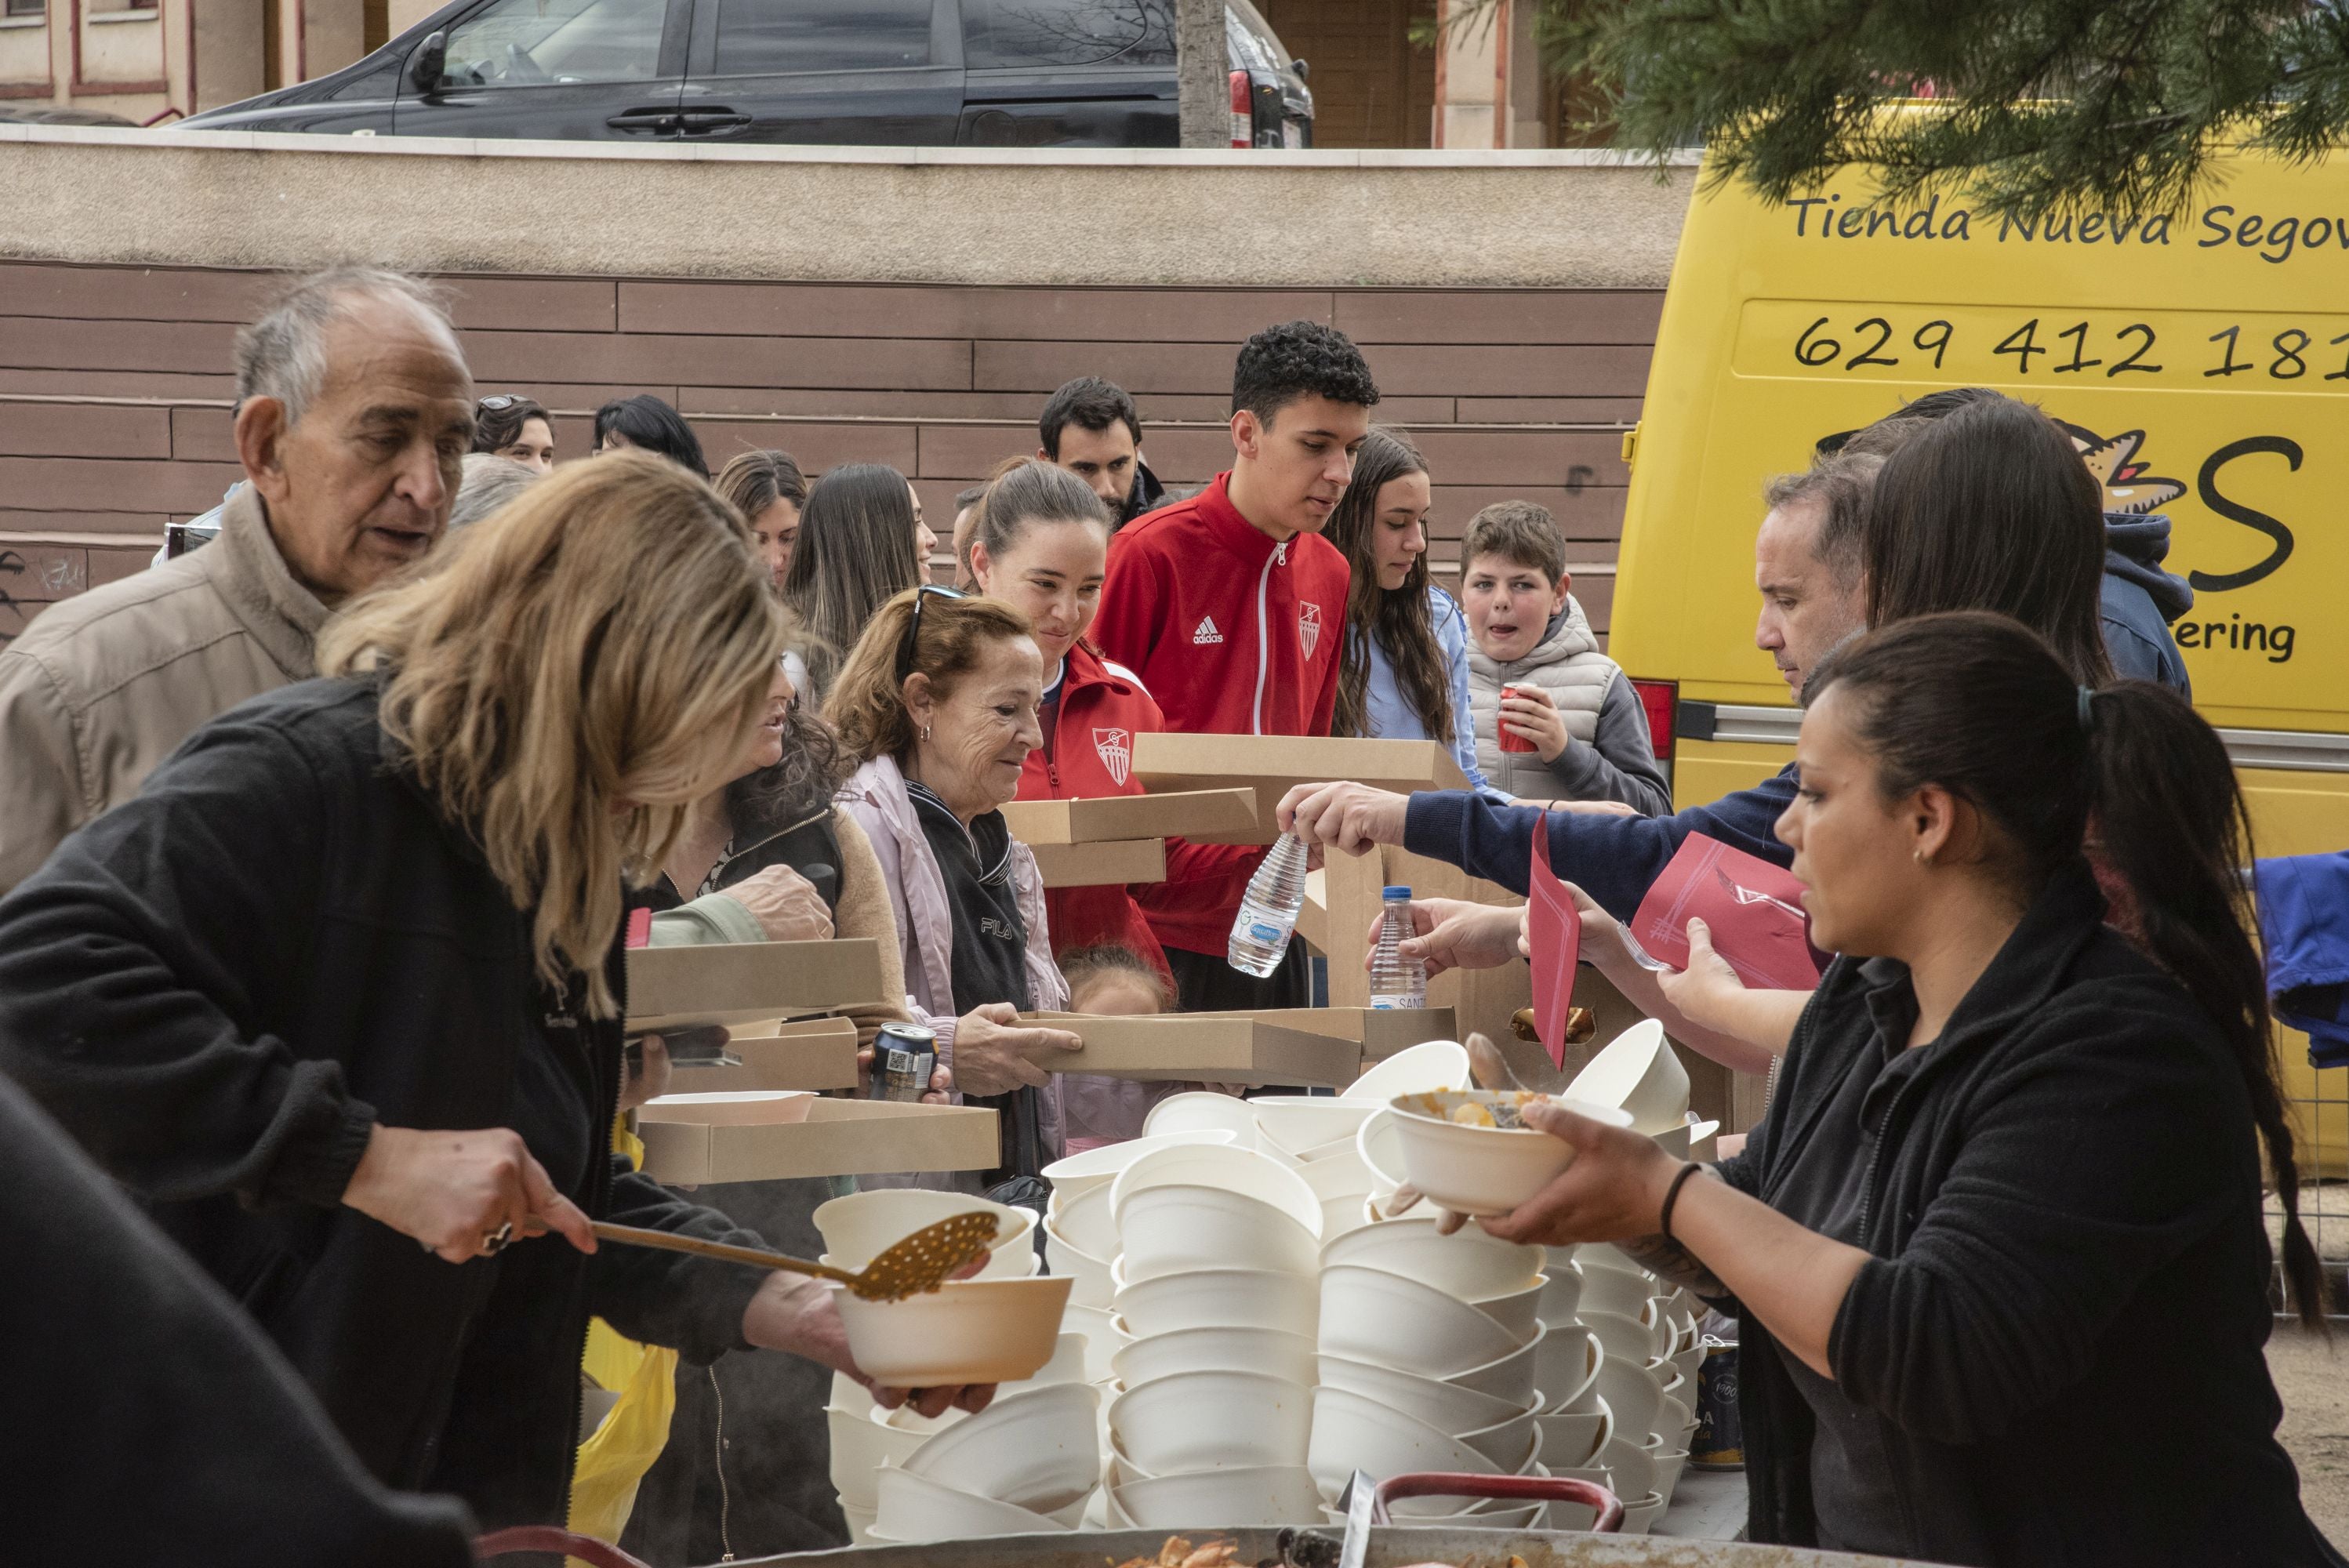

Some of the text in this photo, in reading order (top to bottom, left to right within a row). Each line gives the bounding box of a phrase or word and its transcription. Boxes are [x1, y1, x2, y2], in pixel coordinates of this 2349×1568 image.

[1786, 194, 1970, 240] Tienda
[1998, 204, 2170, 245] Nueva
[1795, 317, 1954, 371] 629
[1993, 318, 2163, 378] 412
[1193, 633, 1224, 644] adidas
[2167, 612, 2296, 663] ering
[981, 917, 1012, 940] FILA
[1715, 1382, 1737, 1397] 1900
